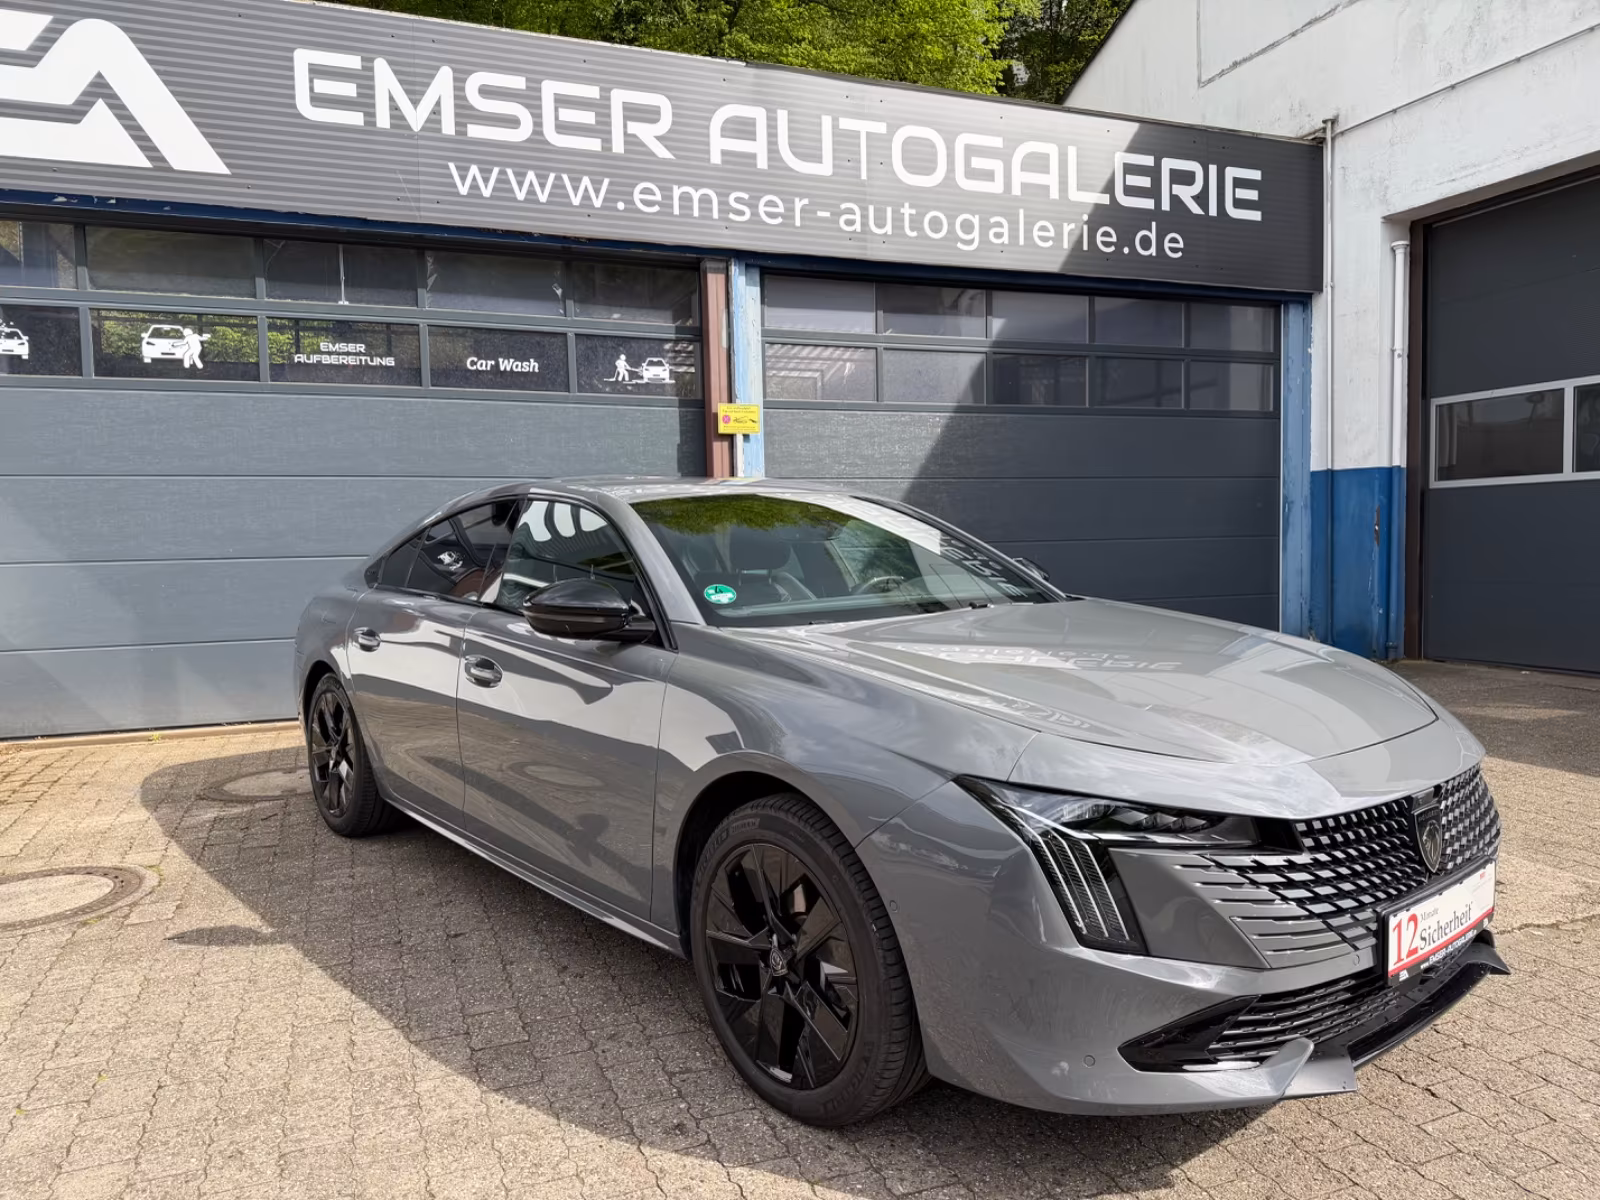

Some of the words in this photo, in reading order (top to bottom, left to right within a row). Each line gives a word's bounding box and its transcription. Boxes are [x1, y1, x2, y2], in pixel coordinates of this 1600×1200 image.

[293, 48, 675, 159] EMSER
[709, 104, 1263, 222] AUTOGALERIE
[447, 161, 1186, 260] www.emser-autogalerie.de
[294, 353, 396, 367] AUFBEREITUNG
[319, 342, 366, 354] EMSER
[466, 356, 495, 372] Car
[498, 357, 540, 373] Wash
[1392, 913, 1419, 966] 12
